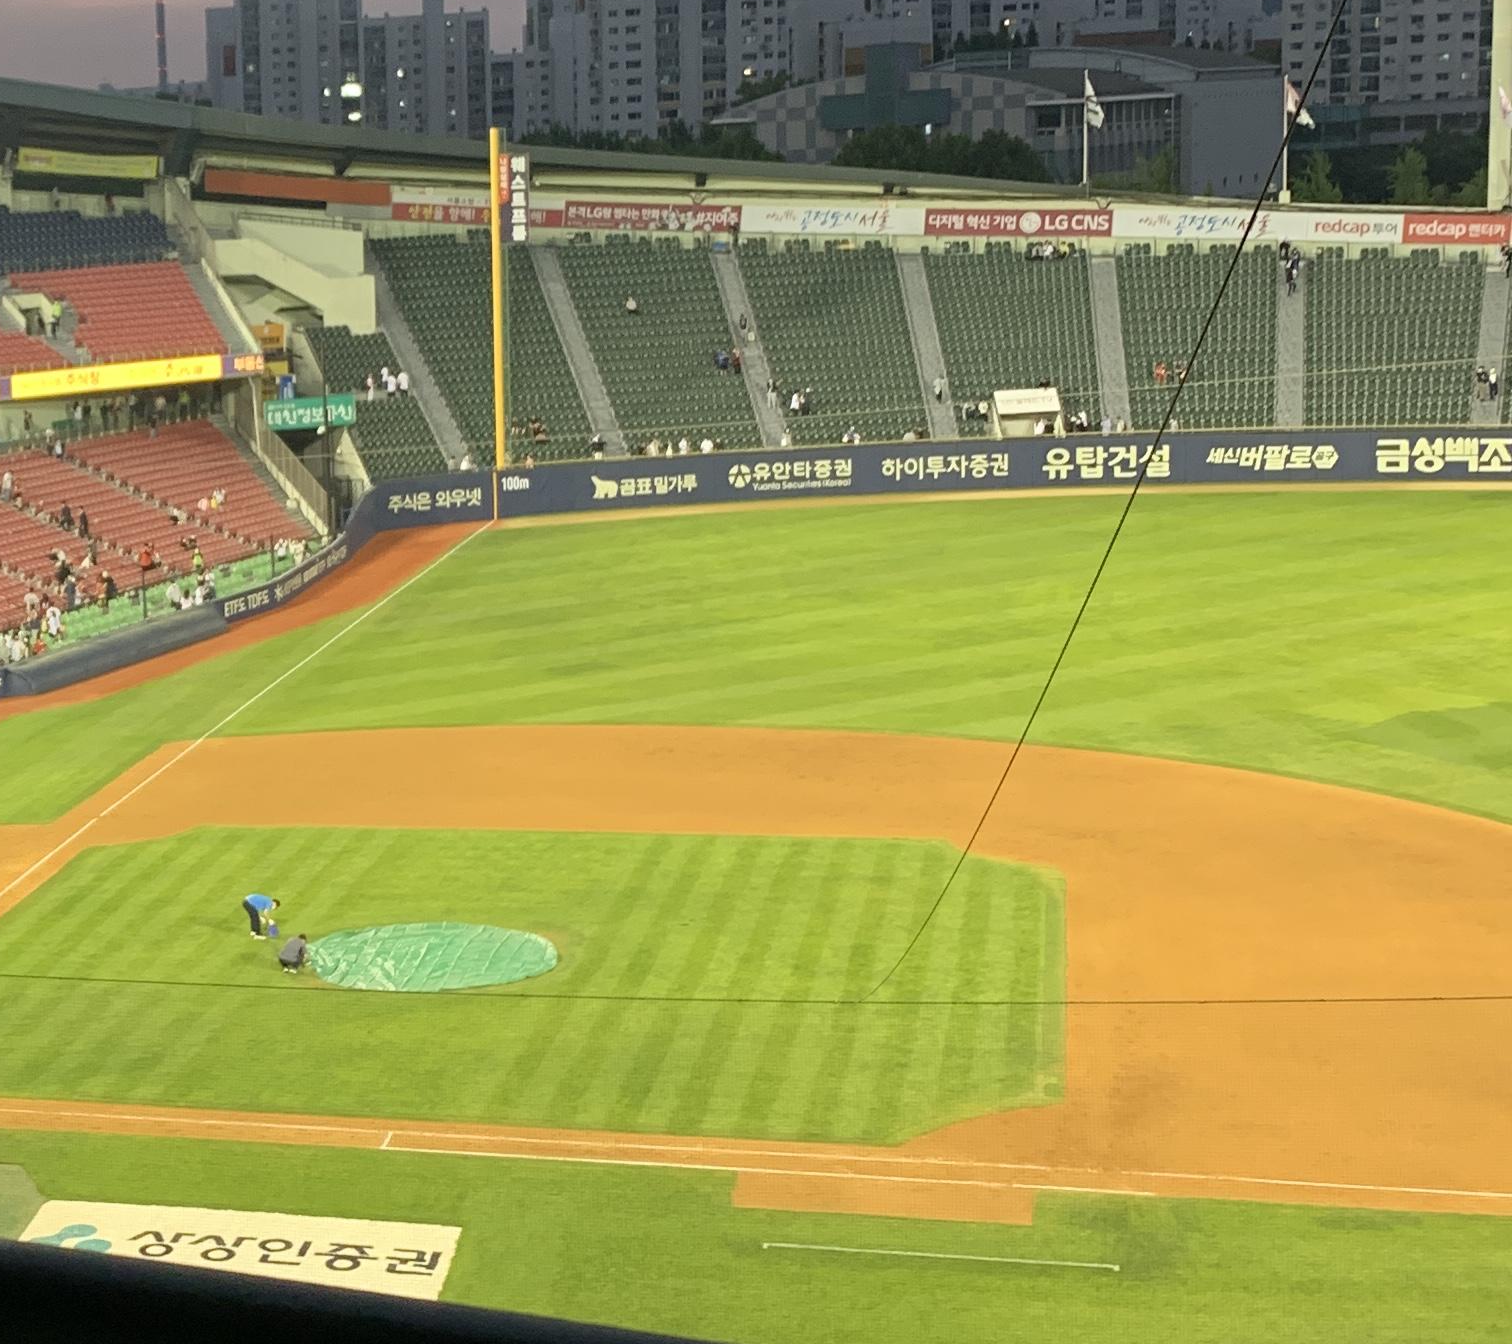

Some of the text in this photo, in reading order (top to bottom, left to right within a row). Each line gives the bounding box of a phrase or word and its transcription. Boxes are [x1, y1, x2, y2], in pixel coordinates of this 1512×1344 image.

[928, 214, 964, 229] 디지털
[993, 214, 1017, 230] 기업
[1044, 214, 1069, 230] LG
[1071, 214, 1109, 230] CNS
[1315, 219, 1398, 236] redcap 투어
[1408, 221, 1466, 239] redcap
[753, 458, 853, 479] 유안타증권
[881, 453, 1009, 481] 하이투자증권
[1042, 444, 1171, 479] 유탑건설
[501, 476, 530, 492] 100m
[620, 474, 697, 497] 곰표 밀가루
[388, 487, 482, 514] 주식은 와우넷
[127, 1229, 443, 1277] 상상인증권
